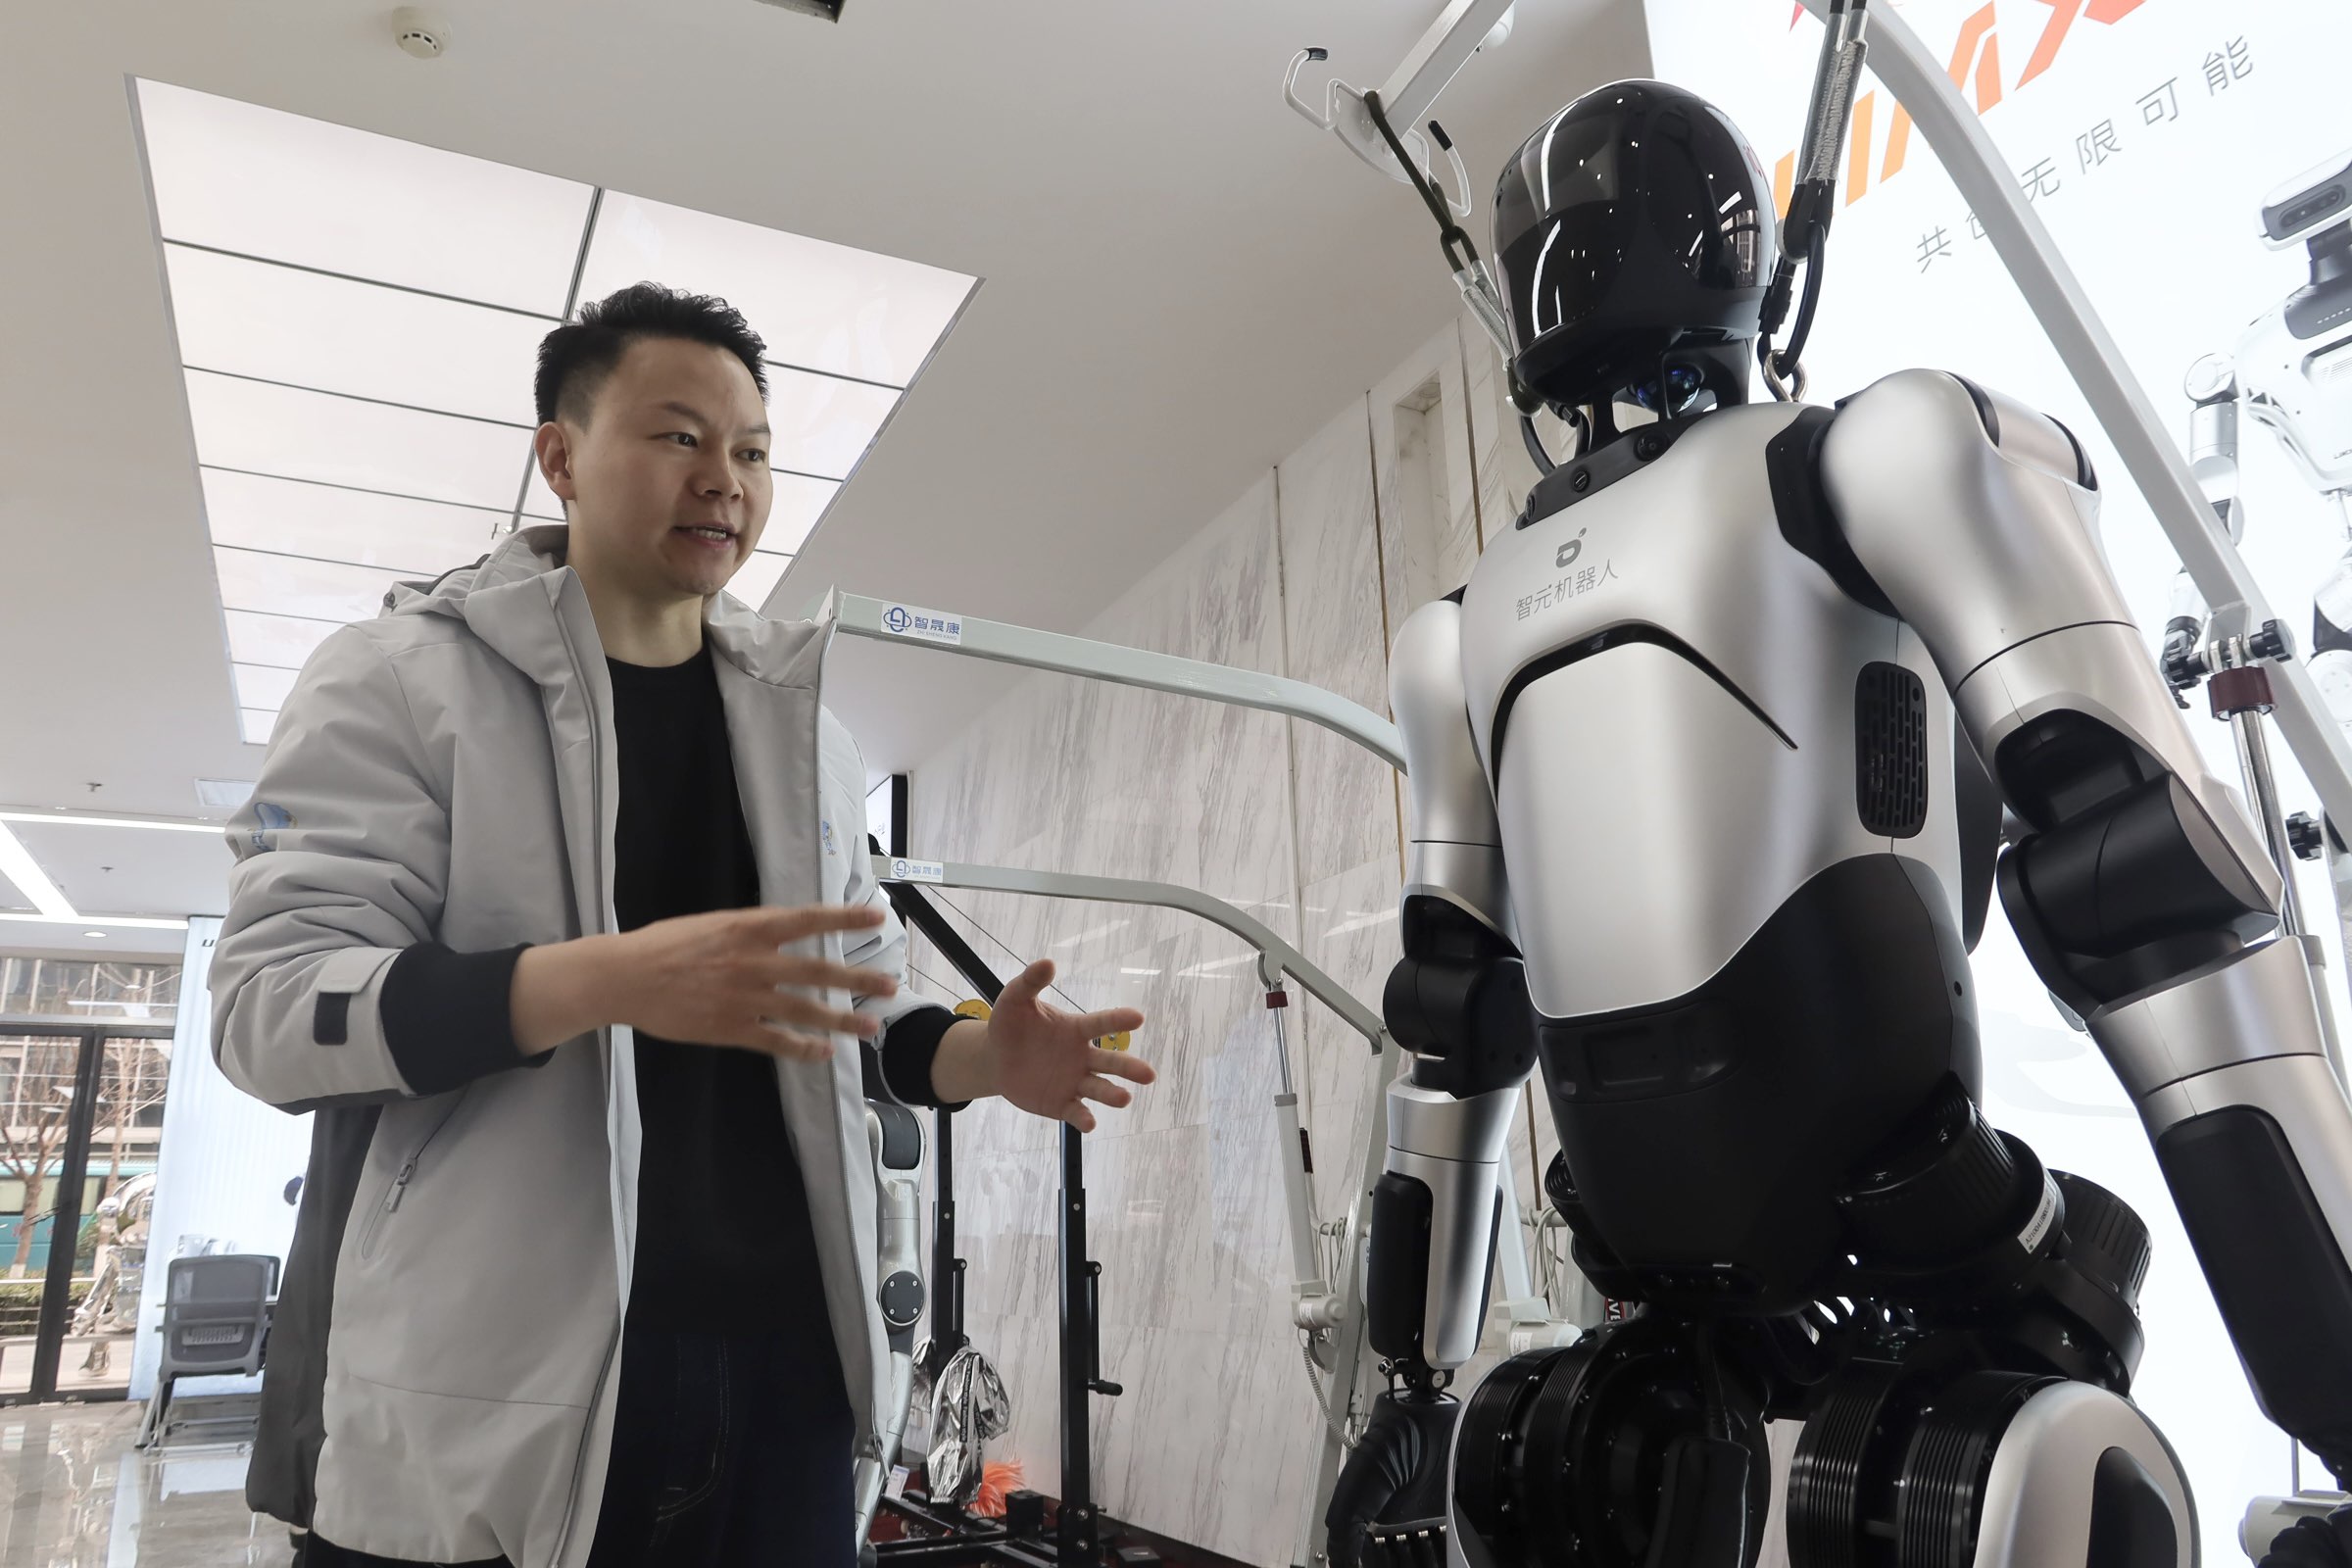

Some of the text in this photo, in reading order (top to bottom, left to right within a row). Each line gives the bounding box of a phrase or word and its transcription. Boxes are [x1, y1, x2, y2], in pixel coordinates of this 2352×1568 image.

[1516, 558, 1619, 621] 智元机器人
[914, 615, 960, 635] 智晟康
